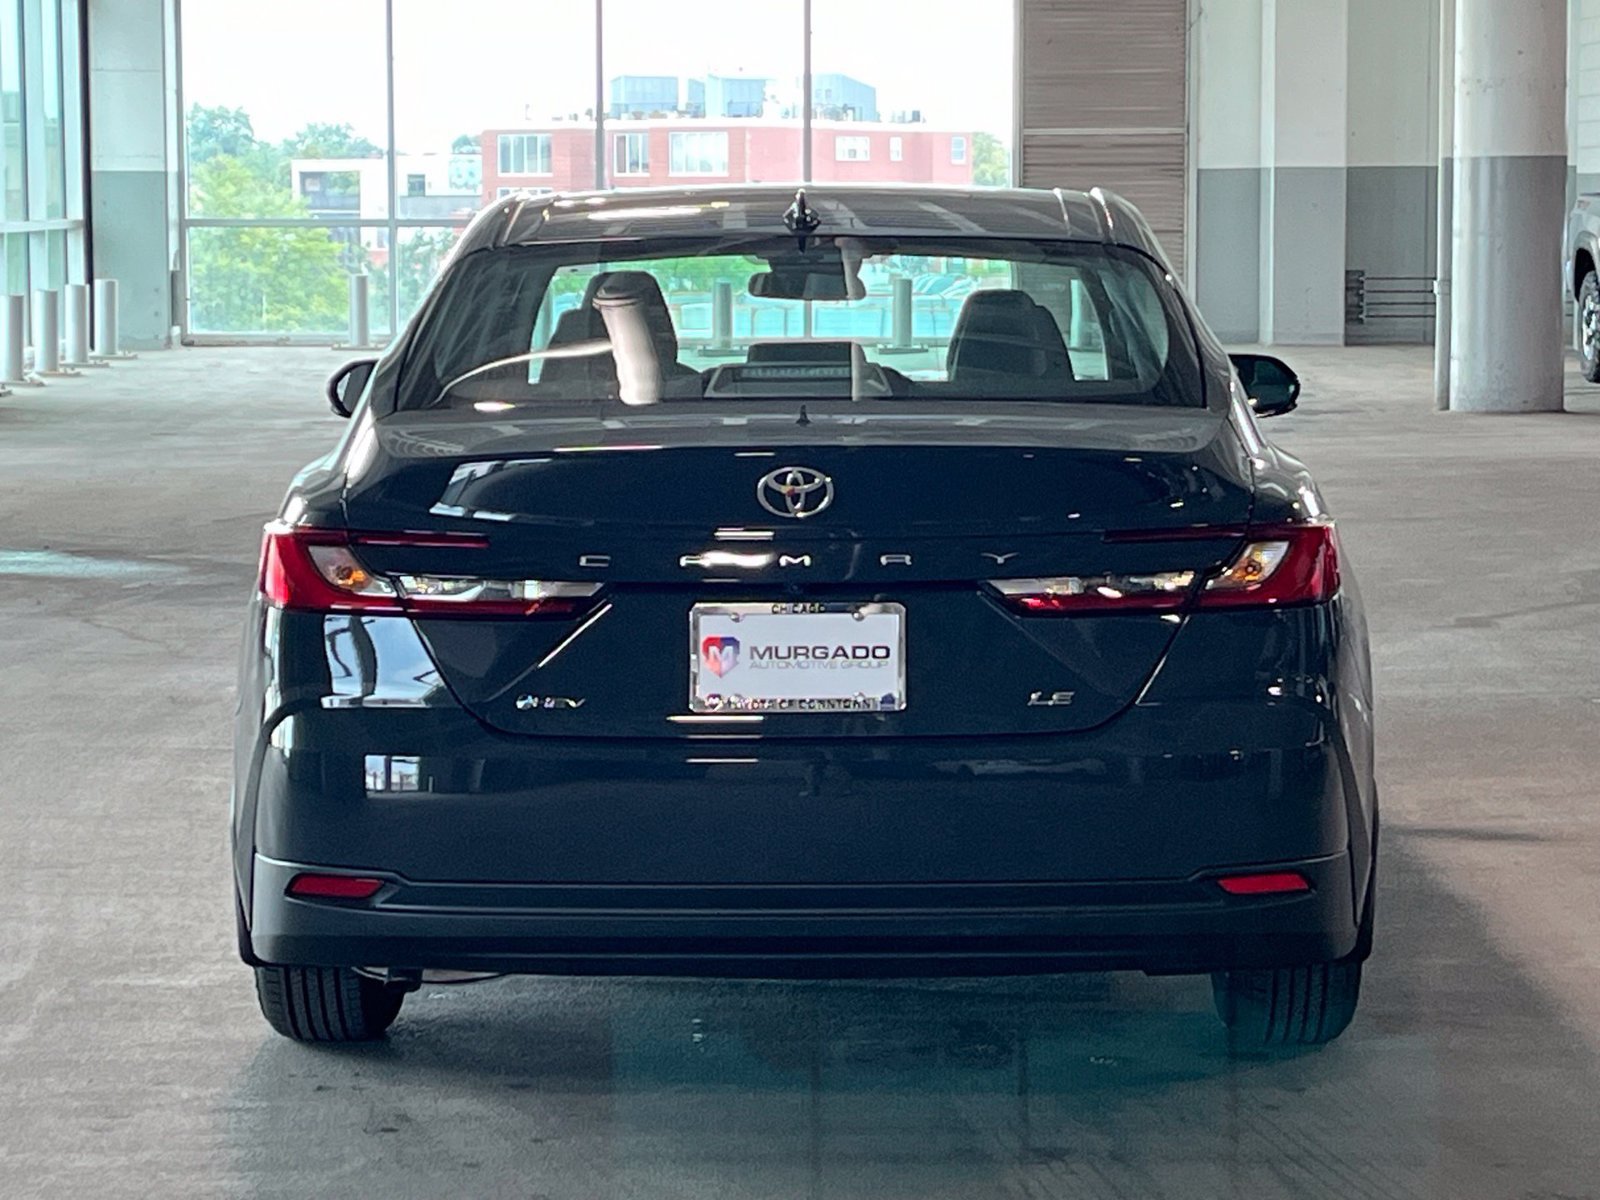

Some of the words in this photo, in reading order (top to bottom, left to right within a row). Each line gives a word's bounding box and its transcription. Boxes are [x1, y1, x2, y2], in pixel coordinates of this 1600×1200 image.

[579, 553, 1019, 568] CAMRY
[749, 645, 891, 660] MURGADO
[749, 660, 837, 669] AUTOMOTIVE
[840, 660, 889, 669] GROUP
[1026, 691, 1076, 706] LE
